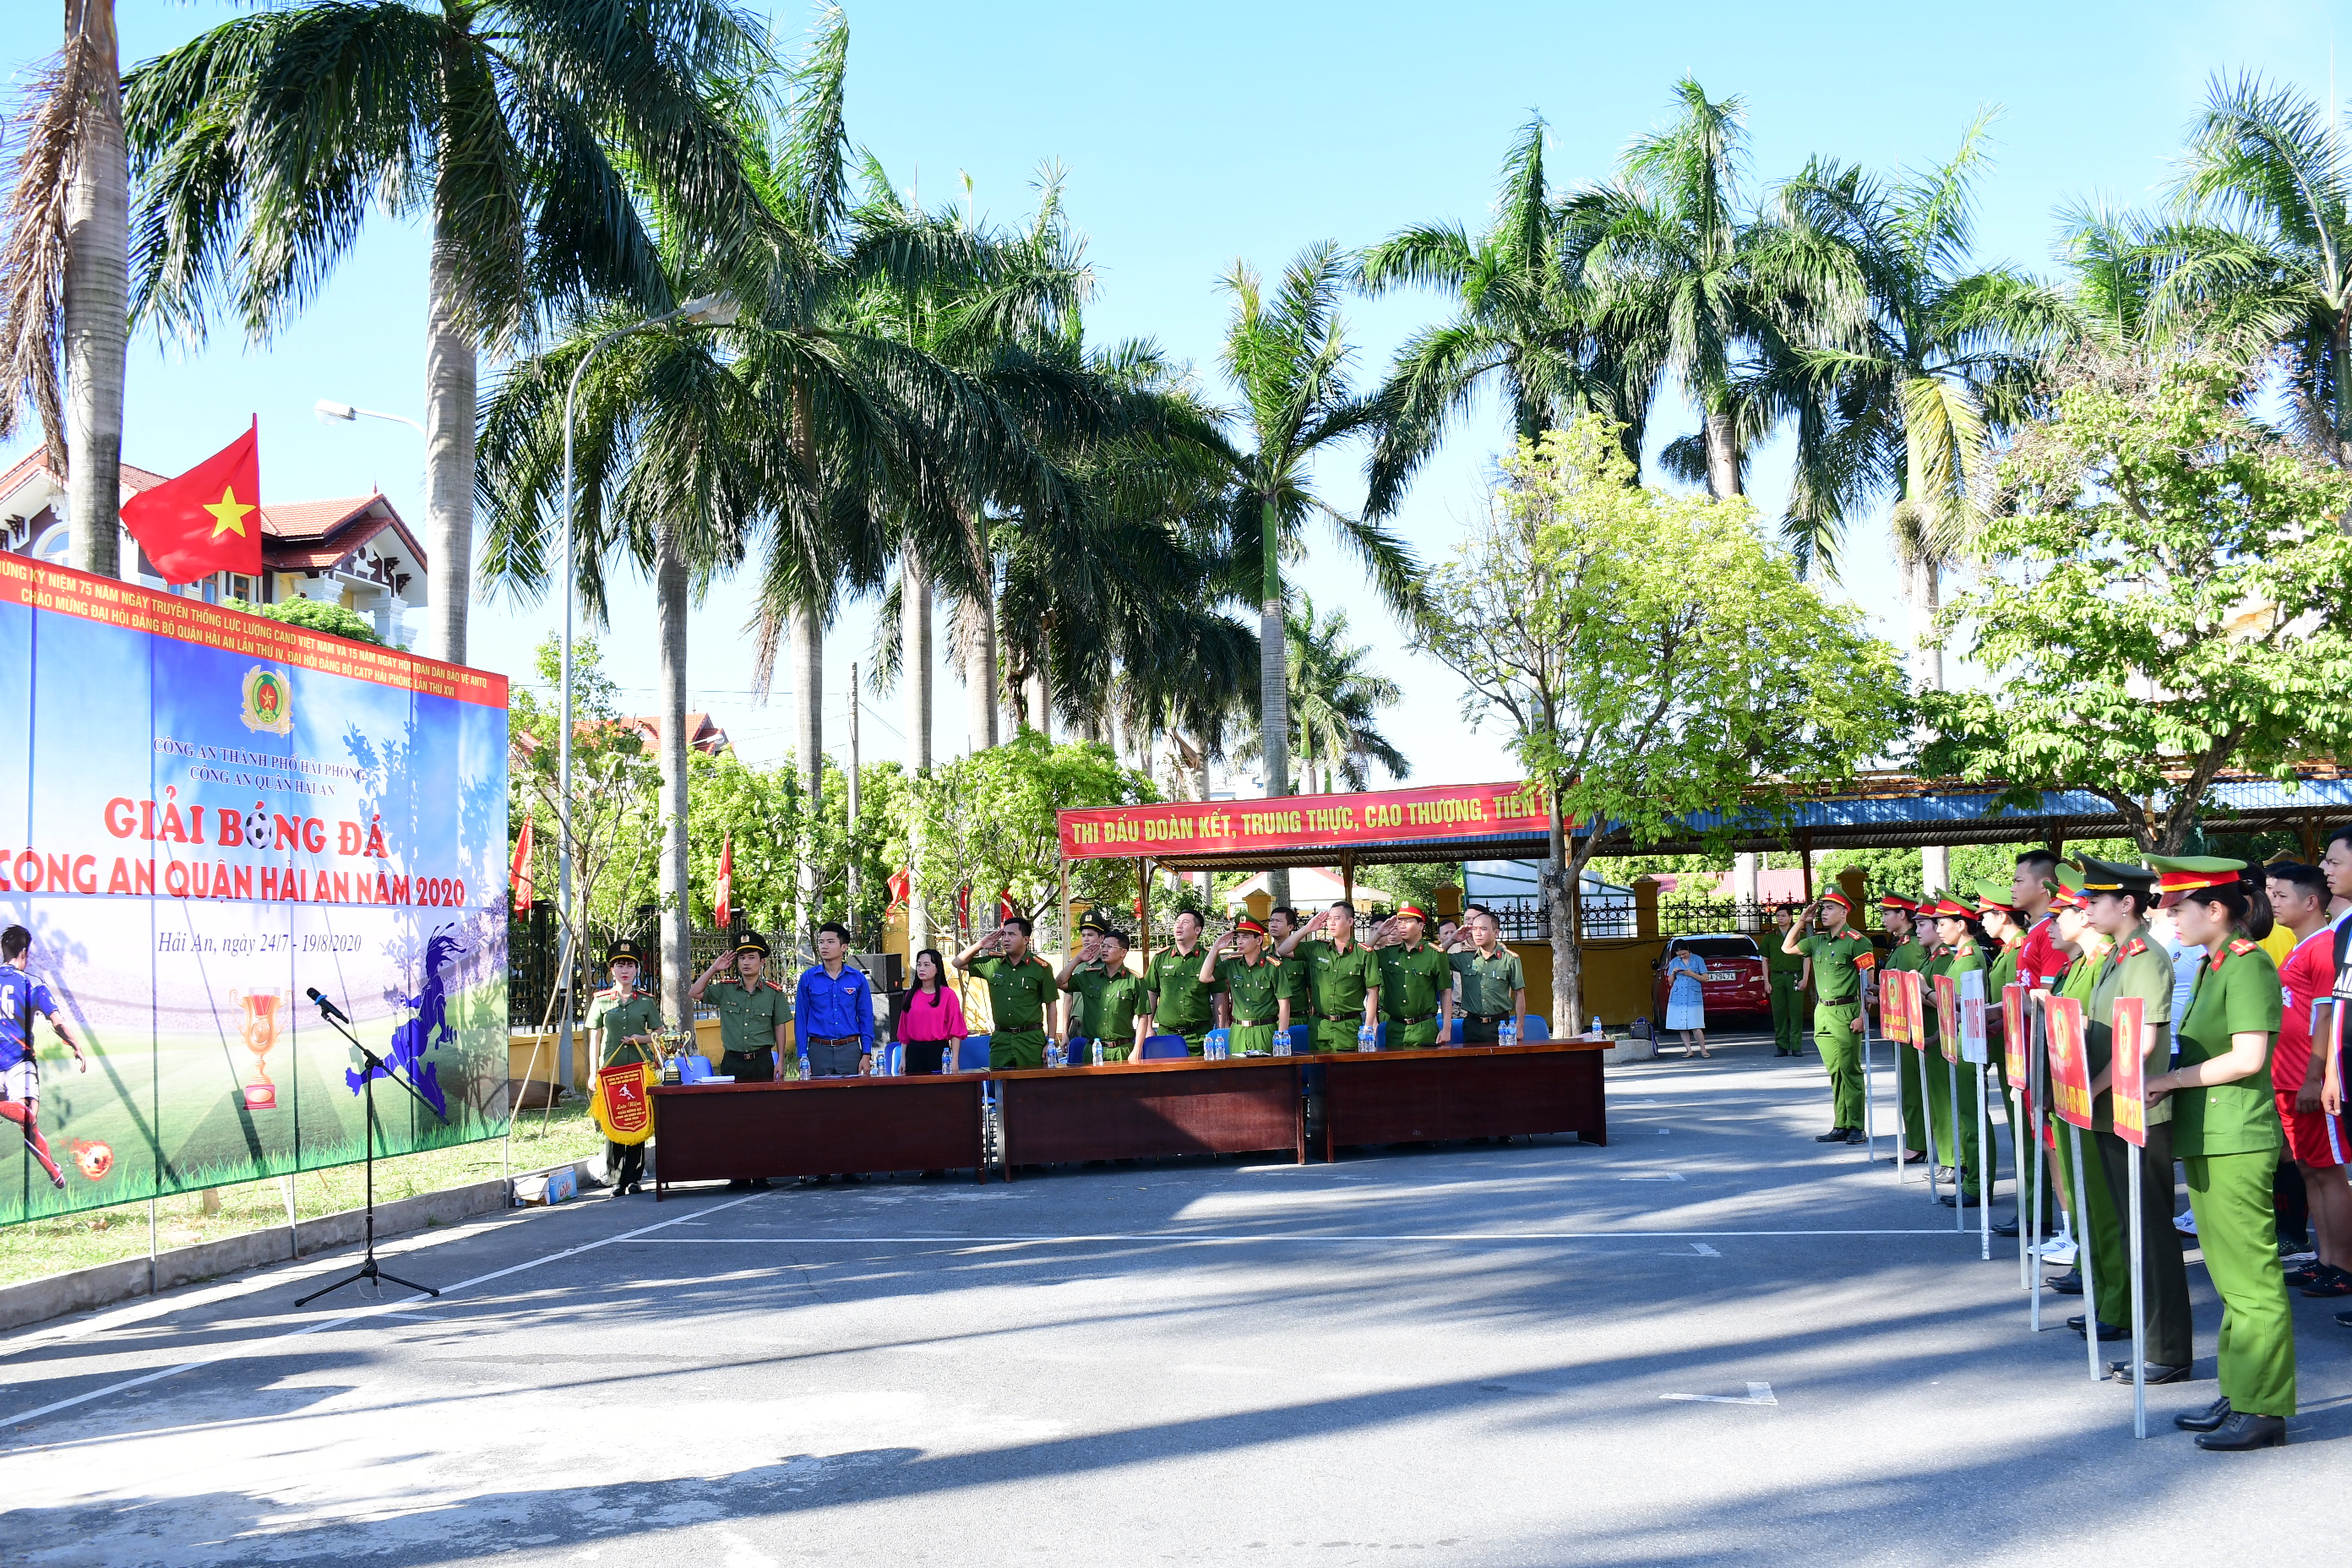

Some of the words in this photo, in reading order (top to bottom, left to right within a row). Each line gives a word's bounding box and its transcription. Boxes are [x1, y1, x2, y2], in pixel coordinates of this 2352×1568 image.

[0, 558, 27, 580] ỪNG
[30, 568, 45, 585] KỶ
[49, 574, 76, 592] NIỆM
[79, 581, 91, 596] 75
[95, 585, 118, 602] NĂM
[122, 592, 149, 608] NGÀY
[151, 599, 188, 618] TRUYỀN
[191, 608, 221, 627] THỐNG
[225, 618, 241, 632] LỰC
[243, 622, 272, 640] LƯỢNG
[274, 629, 296, 645] CAND
[298, 635, 315, 651] VIỆT
[318, 640, 335, 654] NAM
[336, 644, 346, 656] VÀ
[348, 648, 357, 659] 15
[360, 649, 375, 663] NĂM
[378, 655, 397, 668] NGÀY
[399, 658, 411, 672] HỘI
[412, 661, 429, 676] TOÀN
[432, 666, 444, 678] DÂN
[447, 668, 460, 683] BẢO
[461, 672, 469, 686] VỆ
[471, 677, 487, 689] ANTQ
[21, 588, 52, 607] CHÀO
[56, 596, 88, 616] MỪNG
[90, 604, 108, 622] ĐẠI
[112, 608, 128, 626] HỘI
[132, 612, 159, 632] ĐẢNG
[162, 620, 174, 638] BỘ
[177, 625, 203, 642] QUẬN
[205, 629, 220, 645] HẢI
[223, 635, 235, 649] AN
[237, 636, 253, 653] LẦN
[257, 643, 274, 657] THỨ
[275, 649, 286, 662] IV,
[288, 651, 301, 666] ĐẠI
[304, 653, 317, 669] HỘI
[319, 656, 340, 672] ĐẢNG
[342, 662, 351, 676] BỘ
[355, 666, 373, 679] CATP
[375, 668, 387, 683] HẢI
[389, 672, 412, 688] PHÒNG
[429, 681, 443, 694] THỨ
[444, 685, 455, 696] XVI
[154, 736, 194, 757] CÔNG
[198, 745, 218, 760] AN
[220, 748, 267, 767] THÀNH
[270, 753, 297, 771] PHỐ
[301, 758, 321, 776] HẢI
[324, 763, 366, 781] PHÒNG
[190, 764, 230, 784] CÔNG
[233, 773, 252, 786] AN
[255, 774, 292, 792] QUẬN
[296, 777, 316, 794] HẢI
[319, 784, 335, 796] AN
[104, 785, 204, 845] GIẢI
[338, 814, 389, 858] ĐÁ
[1072, 823, 1098, 844] THI
[1104, 813, 1139, 843] ĐẤU
[1145, 814, 1194, 841] ĐOÀN
[1198, 808, 1237, 840] KẾT,
[1241, 810, 1301, 835] TRUNG
[1306, 805, 1359, 835] THỰC,
[1365, 804, 1402, 828] CAO
[1407, 798, 1488, 828] THƯỢNG,
[106, 857, 155, 896] AN
[165, 859, 253, 904] QUẬN
[260, 860, 306, 902] HẢI
[313, 870, 350, 904] AN
[357, 870, 411, 906] NĂM
[416, 876, 466, 907] 2020
[158, 931, 187, 951] Hải
[190, 933, 216, 955] An,
[223, 934, 255, 956] ngày
[259, 934, 289, 951] 24/7
[302, 934, 362, 951] 19/8/2020
